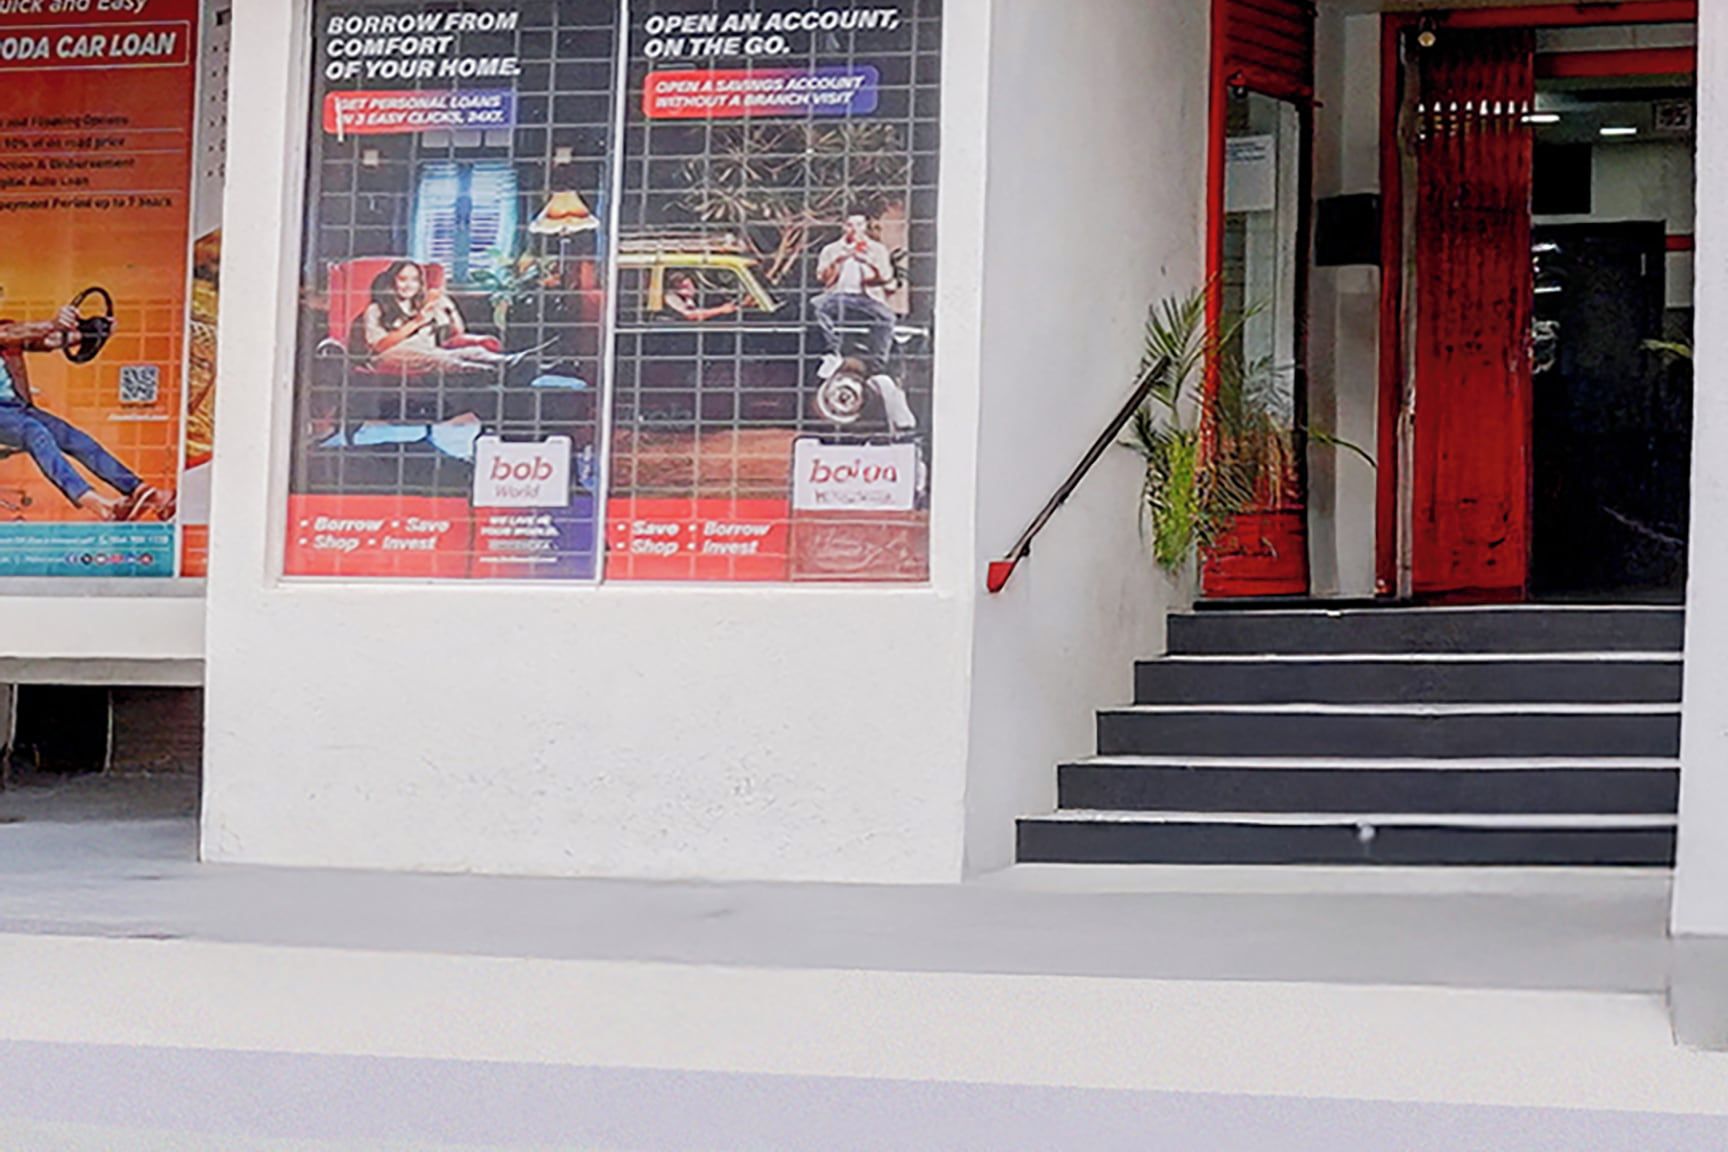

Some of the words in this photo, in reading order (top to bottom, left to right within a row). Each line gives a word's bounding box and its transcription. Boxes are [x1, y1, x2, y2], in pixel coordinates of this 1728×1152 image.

[327, 13, 443, 35] BORROW
[443, 11, 520, 32] FROM
[644, 14, 718, 35] OPEN
[721, 13, 763, 32] AN
[763, 8, 901, 31] ACCOUNT,
[0, 36, 50, 61] ODA
[56, 34, 107, 59] CAR
[109, 31, 178, 57] LOAN
[326, 35, 454, 58] COMFORT
[643, 39, 687, 58] ON
[690, 38, 740, 57] THE
[743, 35, 792, 55] GO.
[325, 60, 363, 80] OF
[364, 58, 436, 79] YOUR
[438, 56, 522, 78] HOME.
[655, 81, 700, 94] OPEN
[701, 80, 714, 93] A
[490, 455, 554, 481] bob
[313, 514, 386, 532] Borrow
[405, 516, 451, 533] Save
[631, 519, 681, 536] Save
[703, 520, 772, 536] Borrow
[313, 533, 361, 553] Shop
[631, 538, 680, 557] Shop
